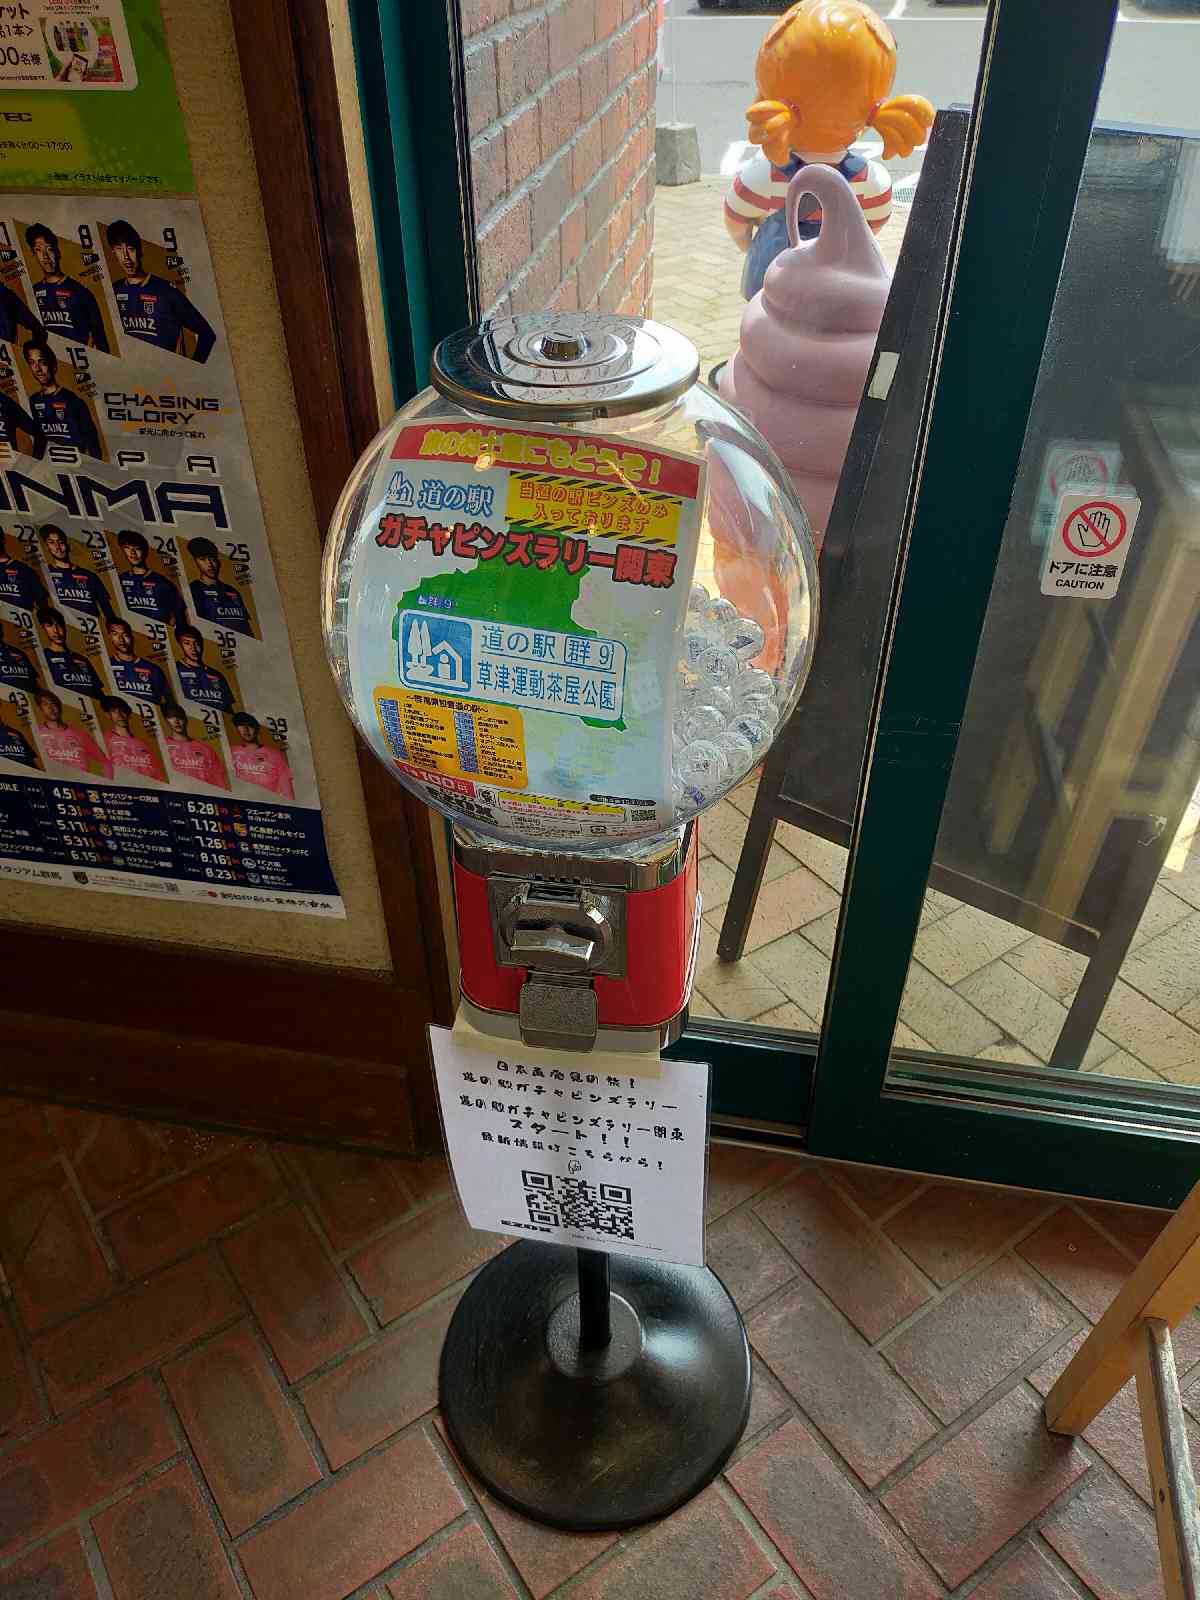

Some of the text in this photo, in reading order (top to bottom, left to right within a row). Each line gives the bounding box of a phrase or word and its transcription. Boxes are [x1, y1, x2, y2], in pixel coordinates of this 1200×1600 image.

[79, 224, 93, 249] 8
[163, 227, 177, 252] 9
[122, 316, 157, 330] CAINZ
[66, 346, 89, 370] 15
[104, 393, 220, 412] CHASING
[108, 408, 194, 425] GLORY
[41, 422, 69, 433] CAINZ
[0, 470, 230, 529] NMA
[417, 479, 494, 518] 道の駅
[533, 503, 650, 535] 入っております
[14, 525, 250, 563] 22 23 24 25
[375, 513, 679, 589] ガチャピンズラリー関東
[1049, 561, 1119, 577] ドアに注意
[1055, 579, 1105, 590] CAUTION
[57, 589, 92, 599] CAINZ
[127, 596, 157, 608] CAINZ
[14, 611, 236, 649] 30 32 35 36
[481, 625, 556, 660] 道の駅
[118, 681, 153, 692] CAINZ
[190, 688, 223, 699] CAINZ
[477, 660, 617, 712] 草津運動茶屋公園
[136, 703, 154, 718] 13
[200, 709, 219, 725] 21
[266, 716, 288, 732] 39
[187, 800, 215, 815] 6.28
[190, 818, 218, 832] 7.12
[194, 835, 223, 849] 7.26
[200, 852, 227, 865] 8.16
[204, 867, 232, 880] 8.23
